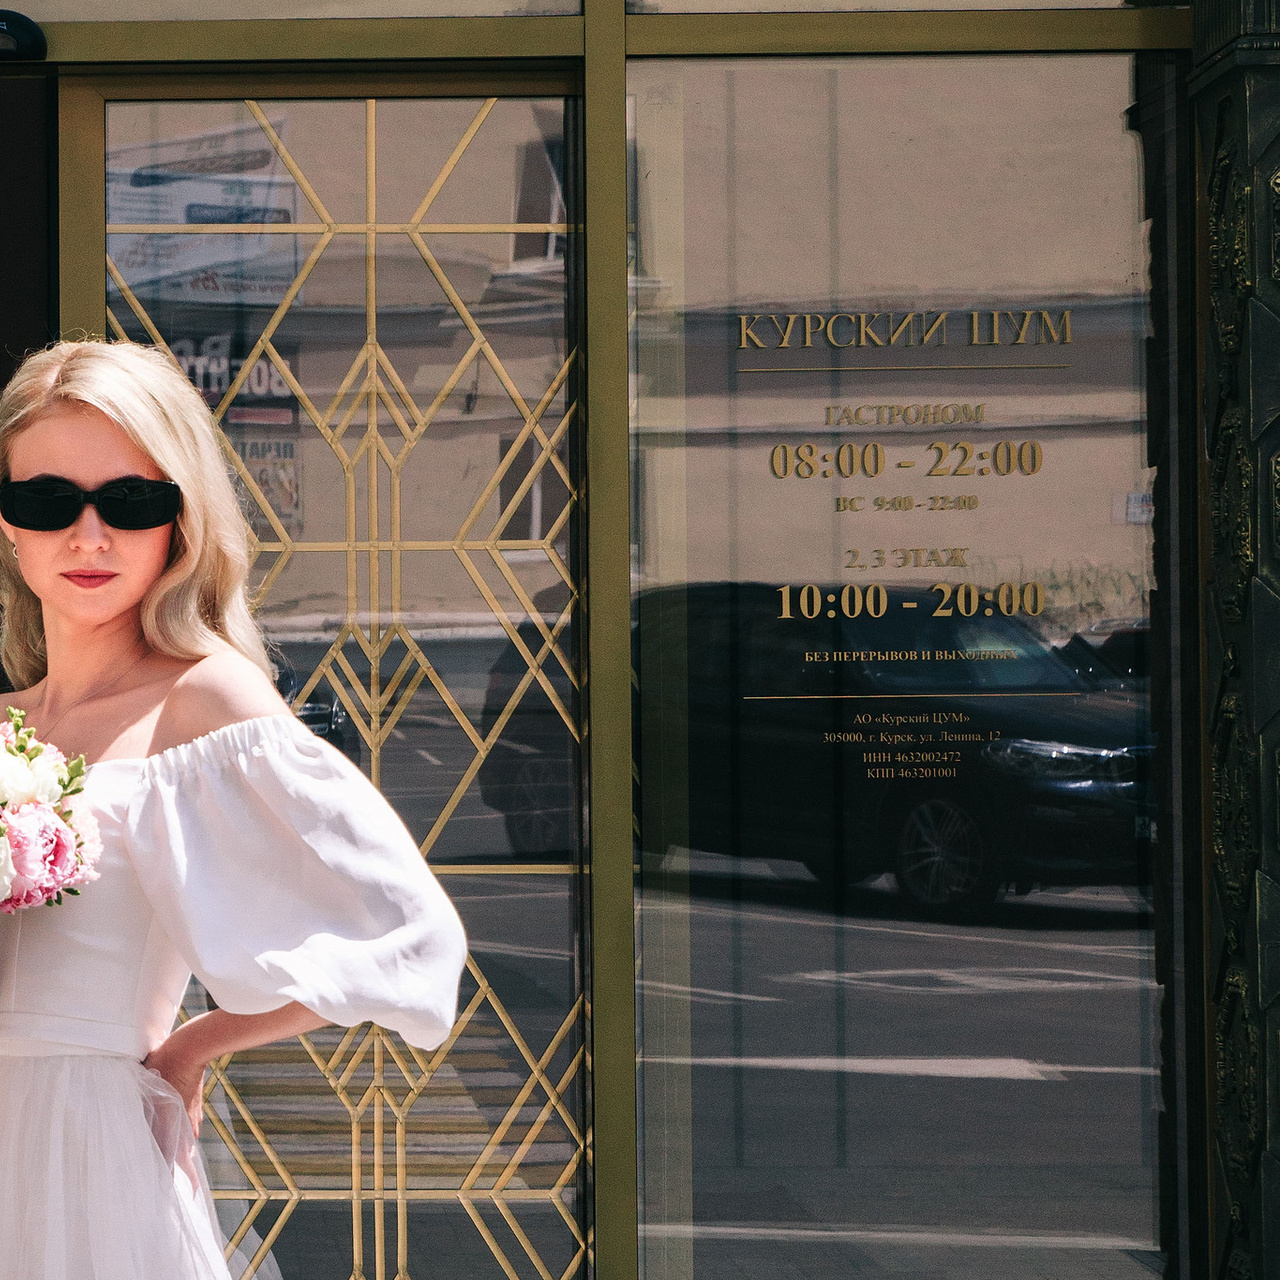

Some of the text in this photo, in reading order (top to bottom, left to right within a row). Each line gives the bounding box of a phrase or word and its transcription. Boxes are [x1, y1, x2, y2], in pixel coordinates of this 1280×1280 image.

[737, 308, 1072, 349] КУРСКИЙ ЦУМ
[824, 403, 987, 426] ГАСТРОНОМ
[771, 442, 886, 479] 08:00
[925, 440, 1044, 477] 22:00
[835, 496, 866, 512] ВС
[873, 495, 915, 511] 9:00
[928, 494, 979, 511] 22:00
[844, 546, 971, 571] 2, 3 ЭТАЖ
[776, 584, 888, 619] 10:00
[930, 582, 1046, 617] 20:00
[804, 649, 1019, 662] БЕЗ ПЕРЕРЫВОВ И ВЫХОДНЫХ
[853, 712, 970, 726] АО «Курский ЦУМ»
[989, 730, 1001, 741] 12
[863, 751, 962, 763] ИНН 4632002472
[867, 767, 957, 779] КПП 463201001
